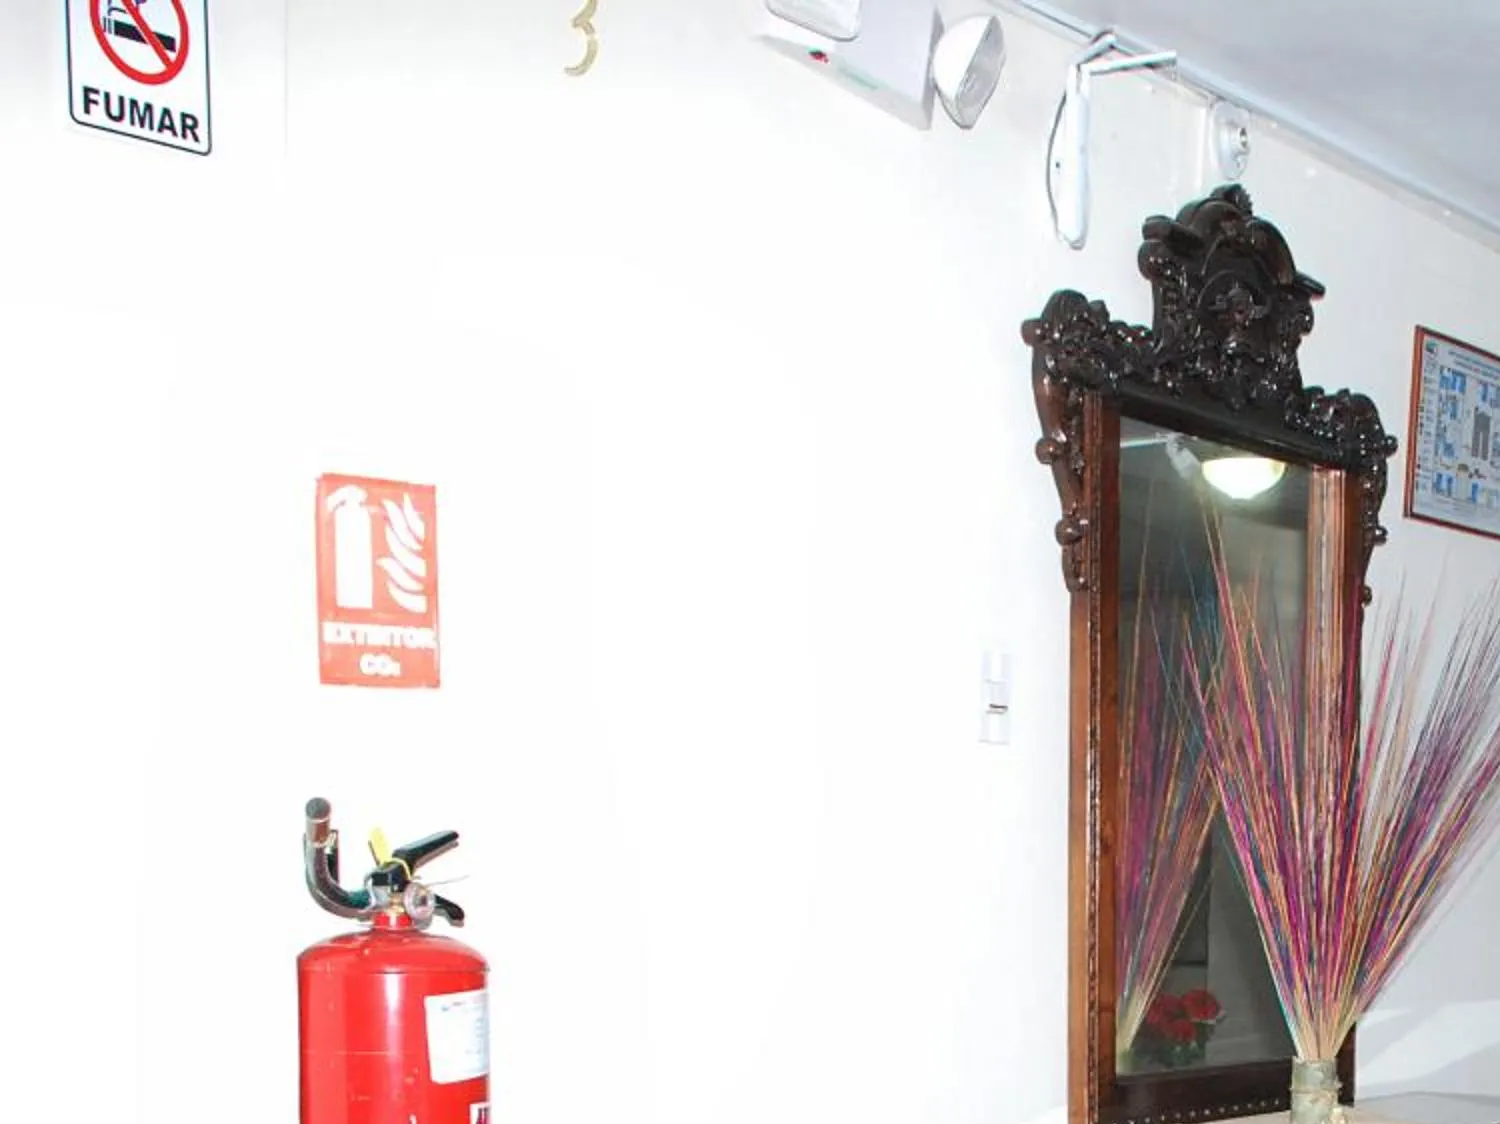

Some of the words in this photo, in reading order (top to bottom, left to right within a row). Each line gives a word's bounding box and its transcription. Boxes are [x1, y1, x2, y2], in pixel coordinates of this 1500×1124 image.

[564, 0, 598, 77] 3
[82, 85, 200, 143] FUMAR
[322, 621, 438, 649] EXTINTOR
